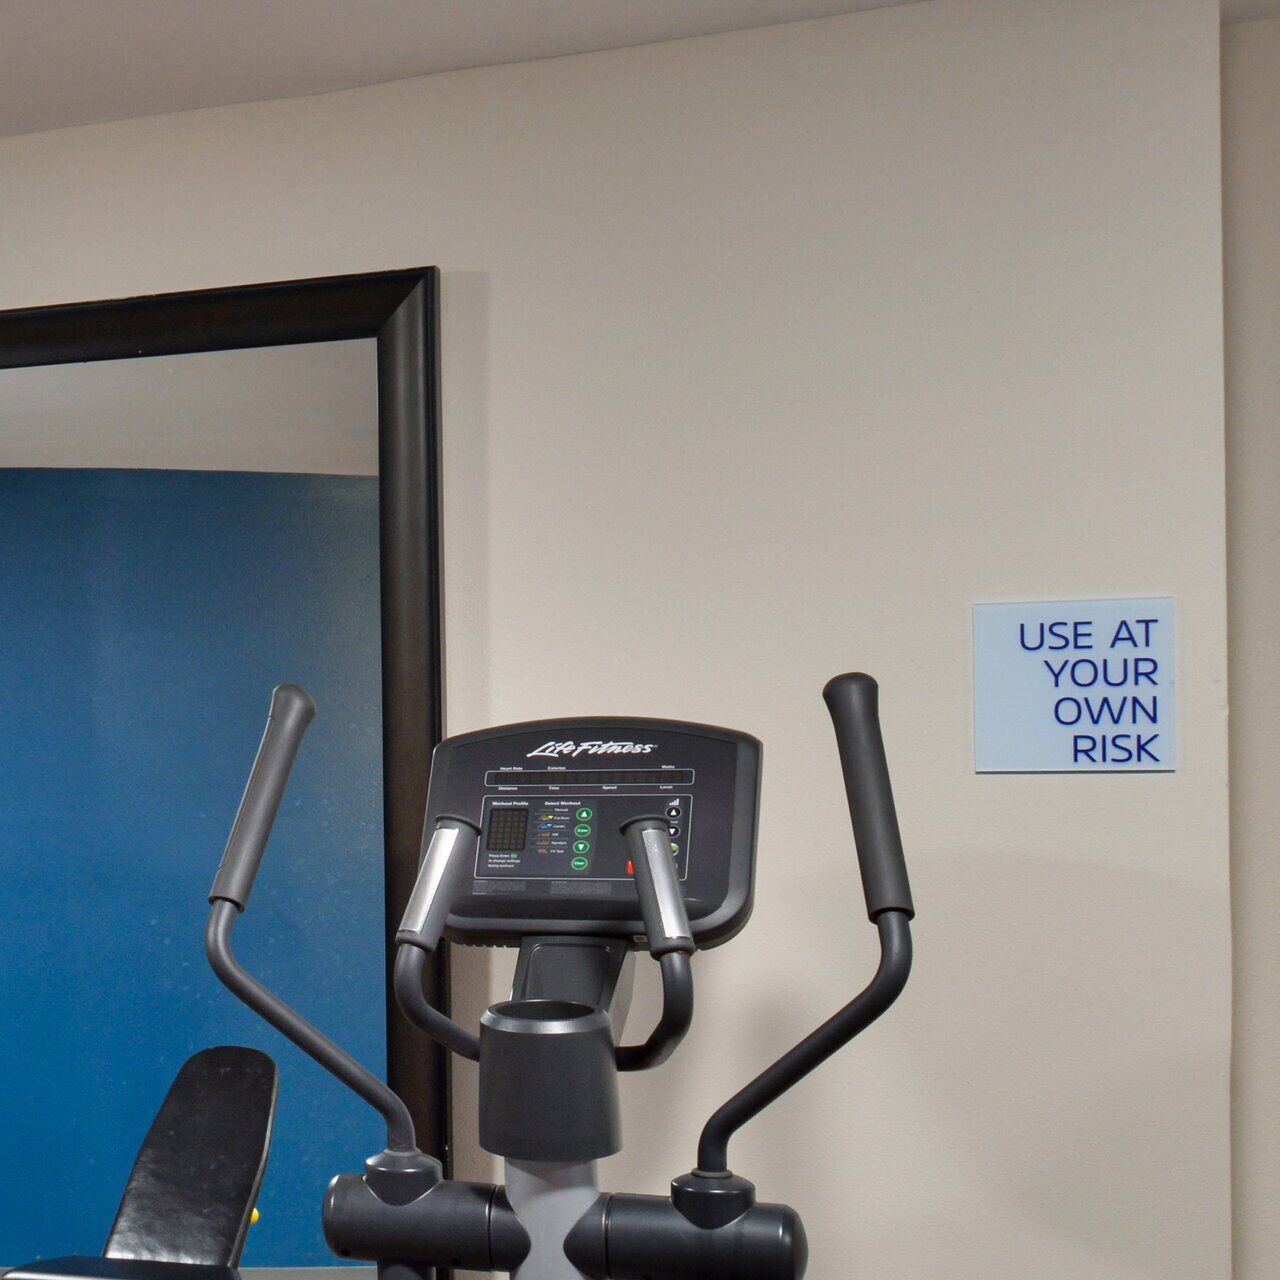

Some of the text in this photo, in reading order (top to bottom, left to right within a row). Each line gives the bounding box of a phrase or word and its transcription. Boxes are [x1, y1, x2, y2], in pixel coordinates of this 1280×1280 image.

[1019, 618, 1159, 651] USE AT
[1042, 657, 1159, 688] YOUR
[1053, 695, 1158, 726] OWN
[1072, 733, 1161, 764] RISK
